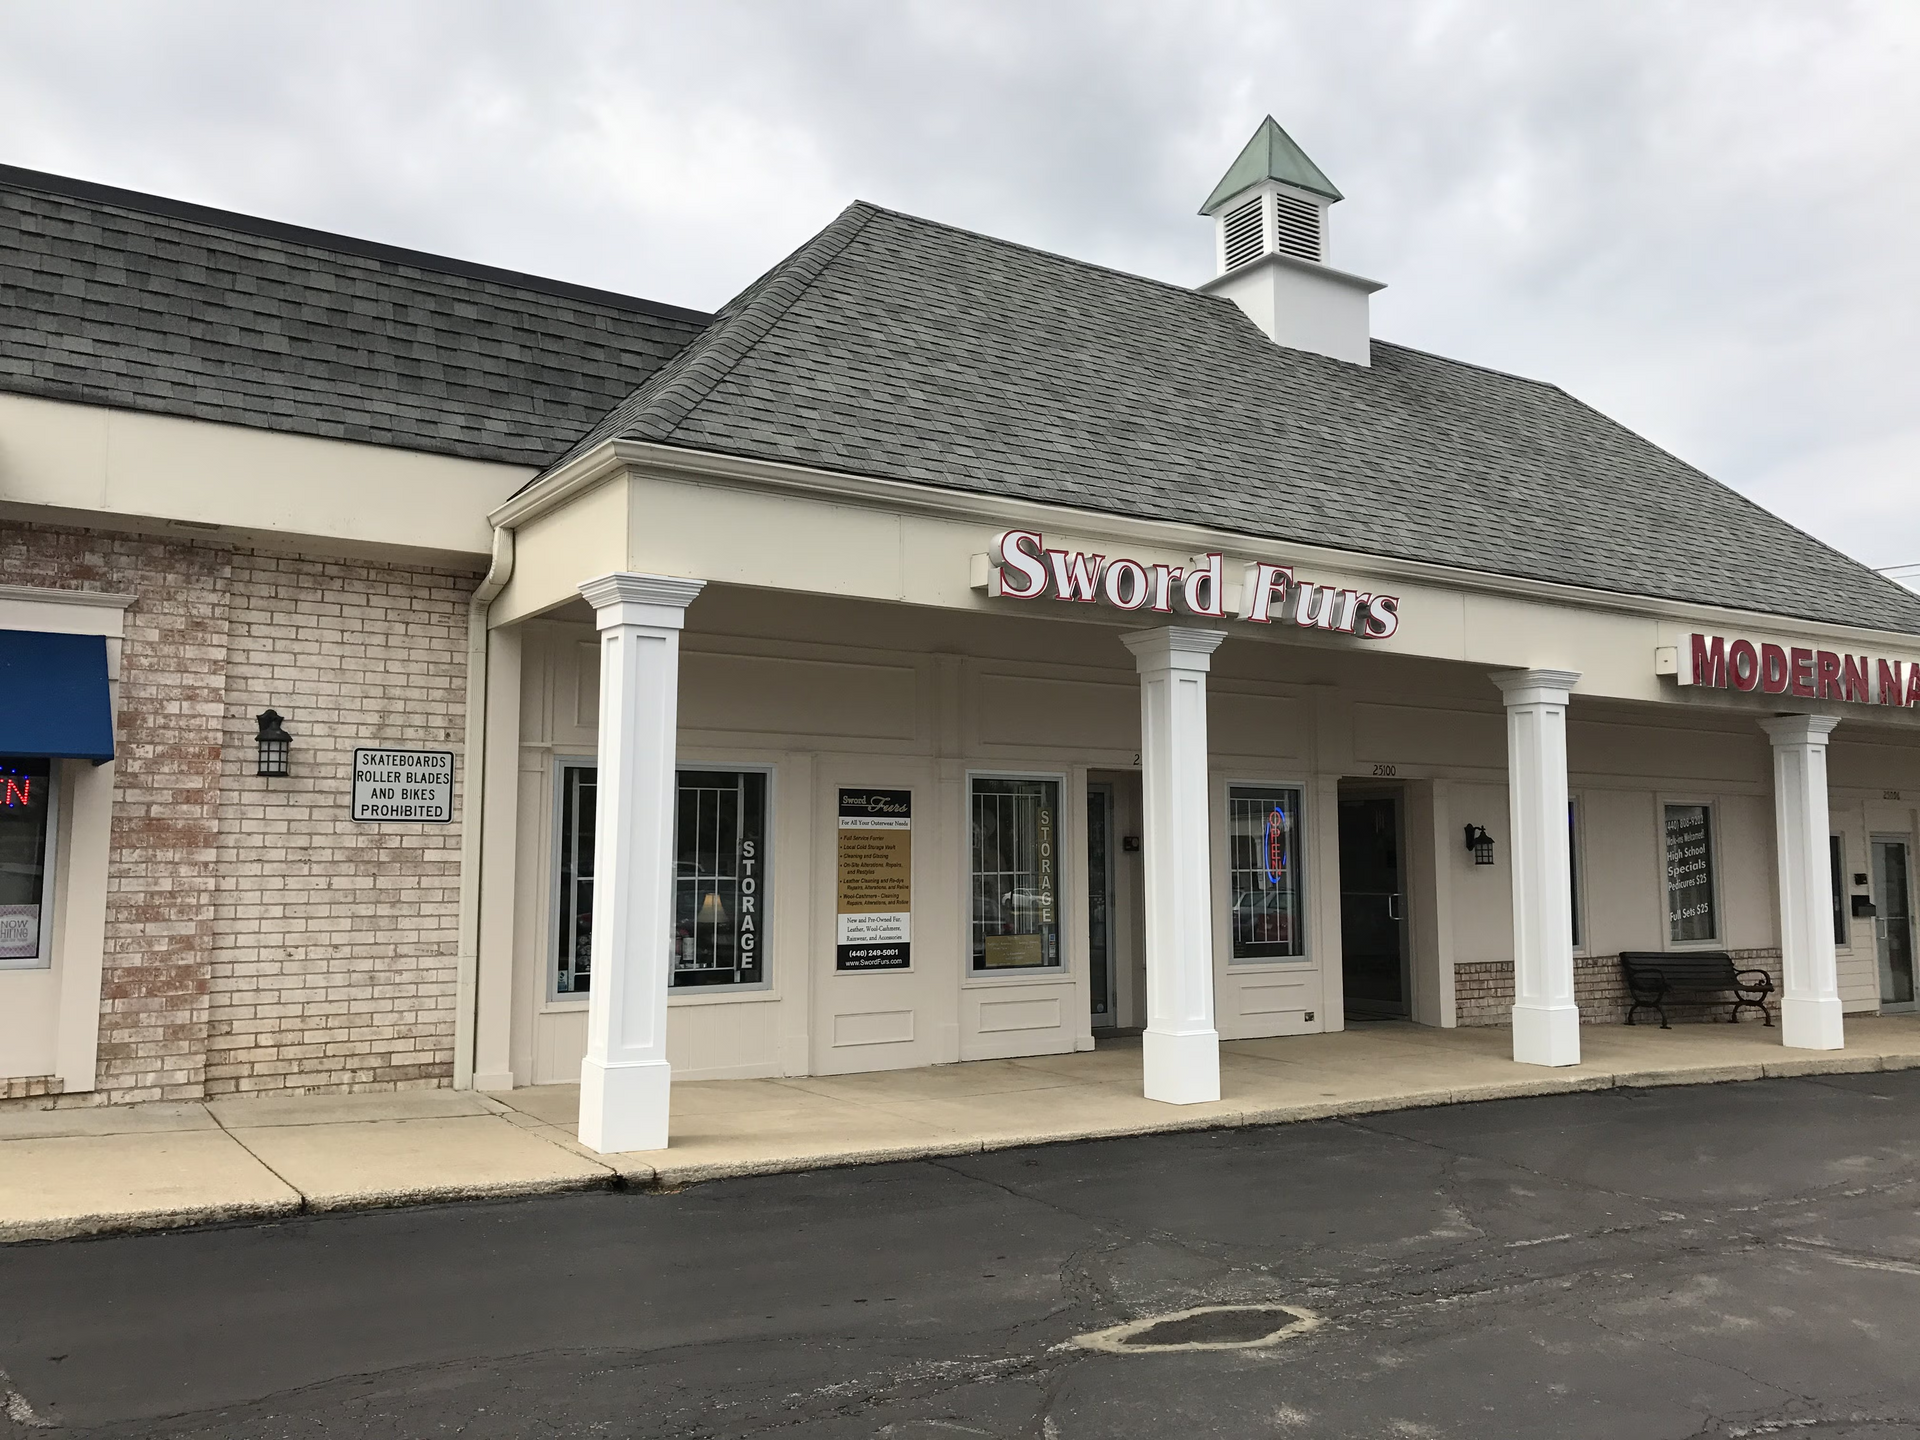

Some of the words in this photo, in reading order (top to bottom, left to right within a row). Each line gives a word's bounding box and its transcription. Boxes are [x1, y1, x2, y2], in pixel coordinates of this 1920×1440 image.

[1000, 529, 1227, 618] Sword
[1248, 561, 1400, 639] Furs
[1691, 633, 1870, 703] MODERN
[362, 753, 446, 768] SKATEBOARDS
[1373, 764, 1396, 776] 25100
[357, 770, 401, 783] ROLLER
[406, 772, 450, 785] BLADES
[0, 779, 30, 805] N
[371, 788, 395, 800] AND
[402, 788, 435, 801] BIKES
[361, 804, 443, 817] PROHIBITED
[842, 795, 866, 804] Sword
[868, 796, 908, 812] Furs
[1269, 811, 1282, 876] OPEN
[1667, 848, 1683, 862] High
[1684, 843, 1706, 858] School
[1041, 810, 1052, 922] STORAGE
[1668, 859, 1706, 878] Specials
[1668, 879, 1695, 891] Pedicures
[1696, 873, 1707, 885] $25
[741, 840, 756, 969] STORAGE
[1670, 909, 1681, 922] Full
[1682, 908, 1696, 919] Sets
[1696, 902, 1709, 915] $25
[1, 920, 28, 929] NOW
